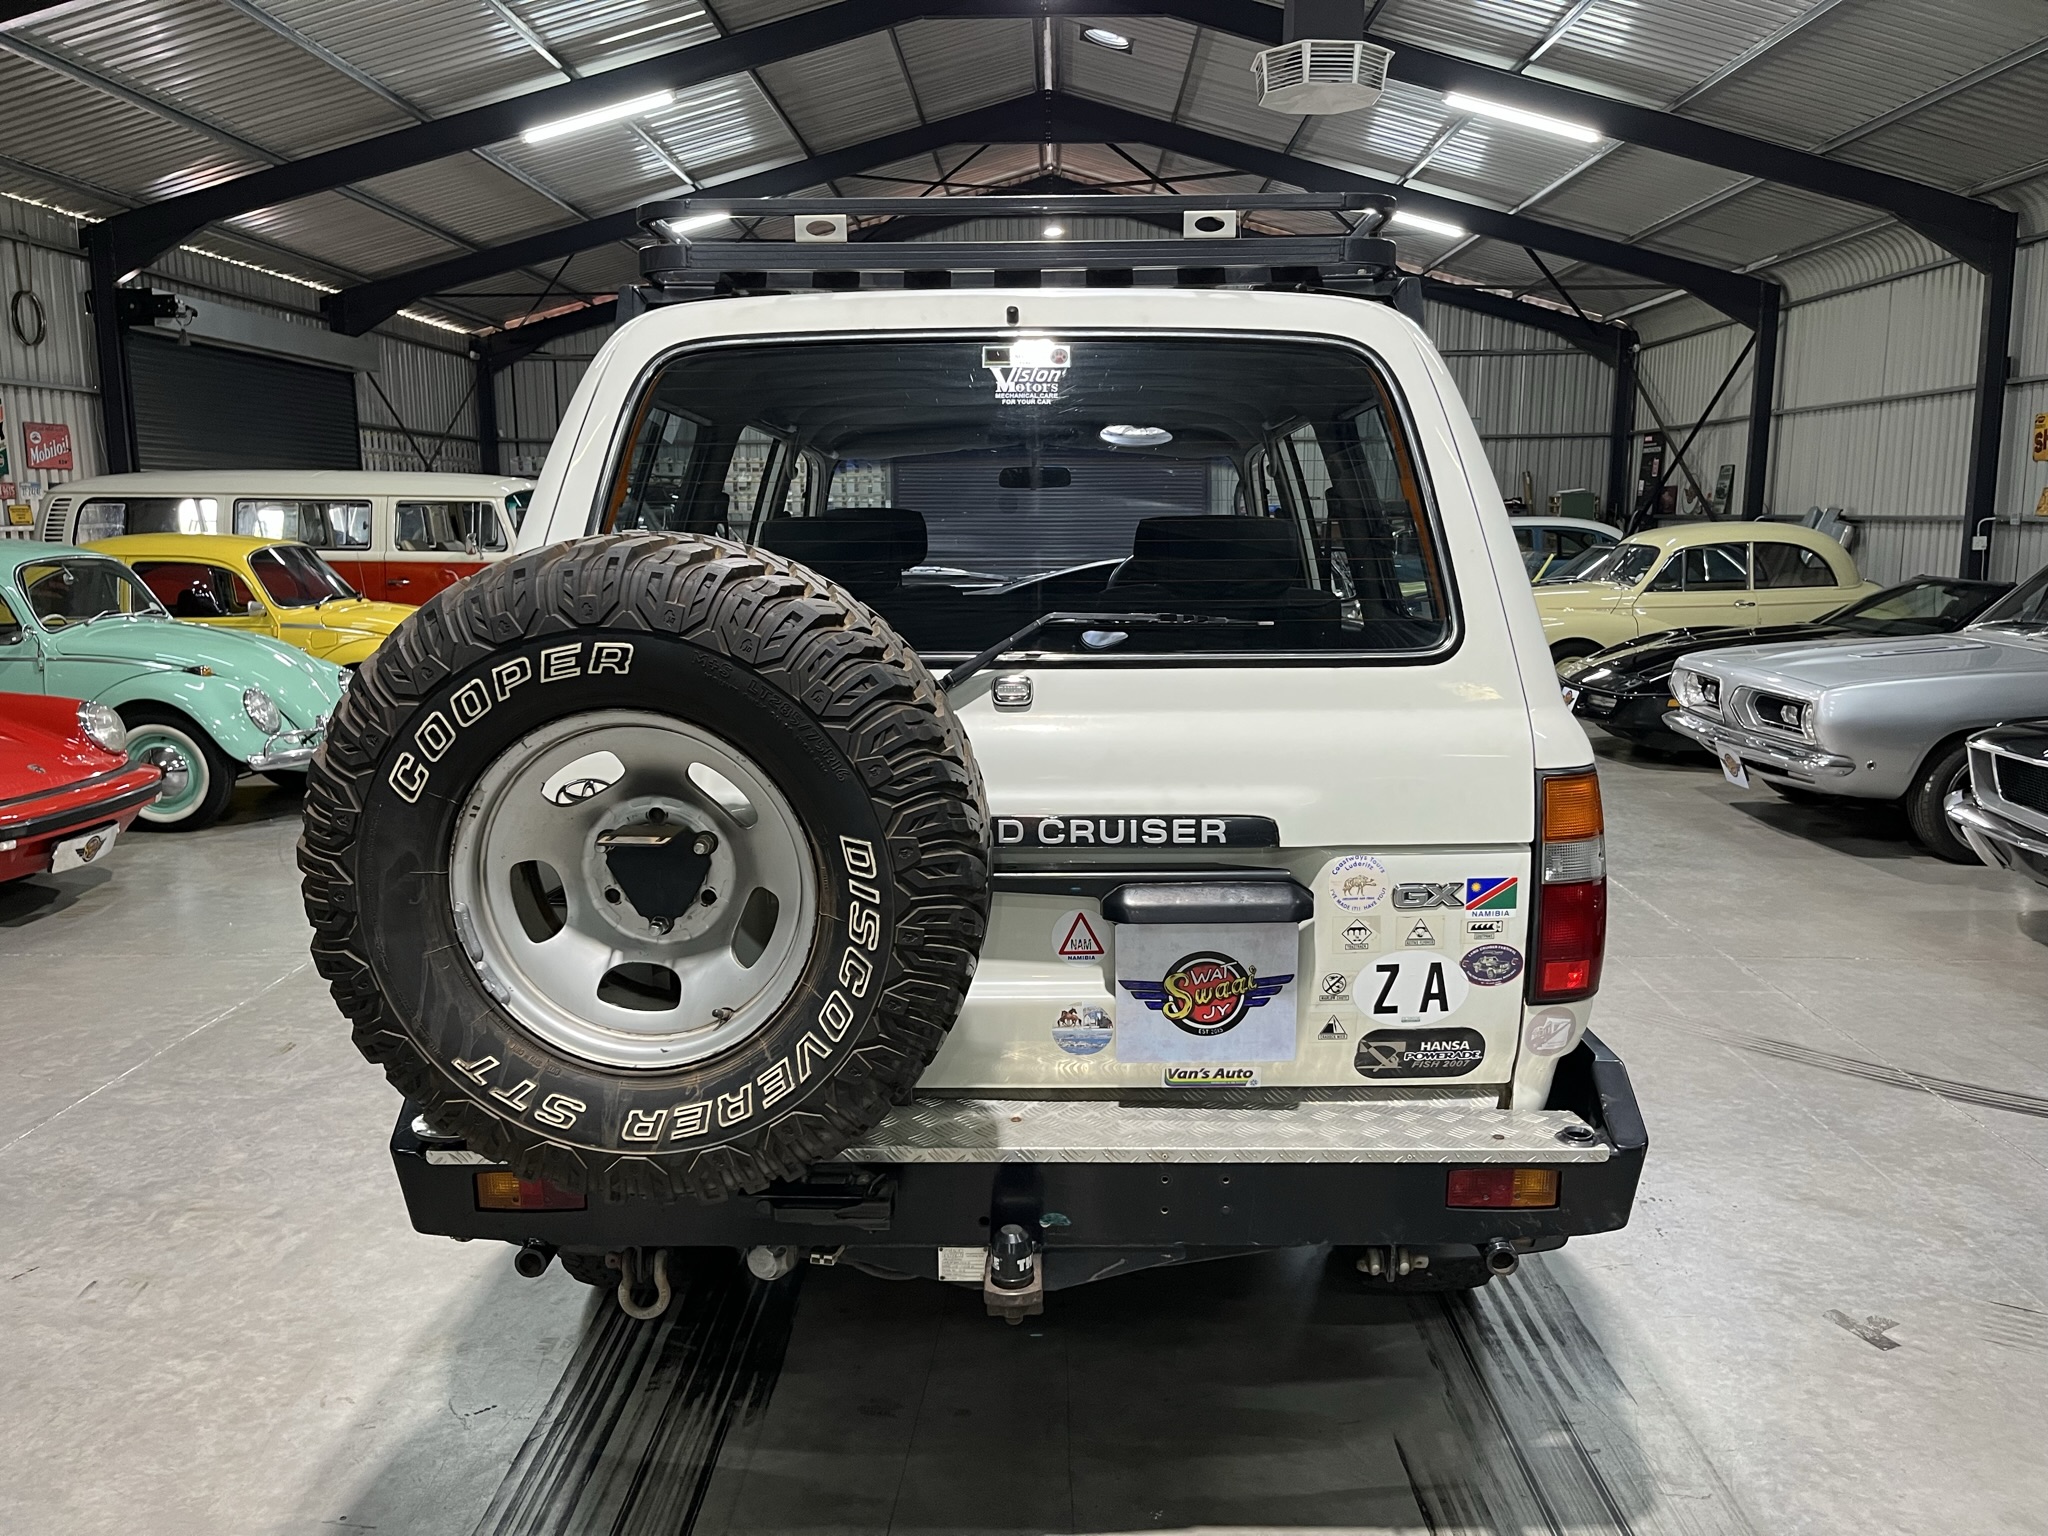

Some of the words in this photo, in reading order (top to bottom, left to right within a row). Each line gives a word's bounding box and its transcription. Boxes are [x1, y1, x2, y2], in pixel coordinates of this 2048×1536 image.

[995, 382, 1059, 392] Motors
[692, 650, 734, 678] M+S
[388, 640, 635, 803] COOPER
[997, 819, 1025, 844] D
[1037, 819, 1227, 844] CRUISER
[1331, 854, 1368, 875] Coastways
[1392, 882, 1465, 909] GX
[1070, 939, 1092, 951] NAM
[1190, 962, 1238, 986] WAT
[620, 834, 878, 1142] DISCOVERER
[1162, 965, 1258, 1020] Swaai
[1373, 963, 1400, 1014] Z
[1418, 962, 1449, 1012] A
[1203, 1003, 1231, 1019] JY
[1403, 1050, 1482, 1061] POWERADE
[1420, 1040, 1470, 1051] HANSA
[1168, 1068, 1210, 1079] Van's
[1212, 1068, 1254, 1079] Auto
[1411, 1060, 1440, 1068] FISH
[451, 1054, 587, 1131] STT
